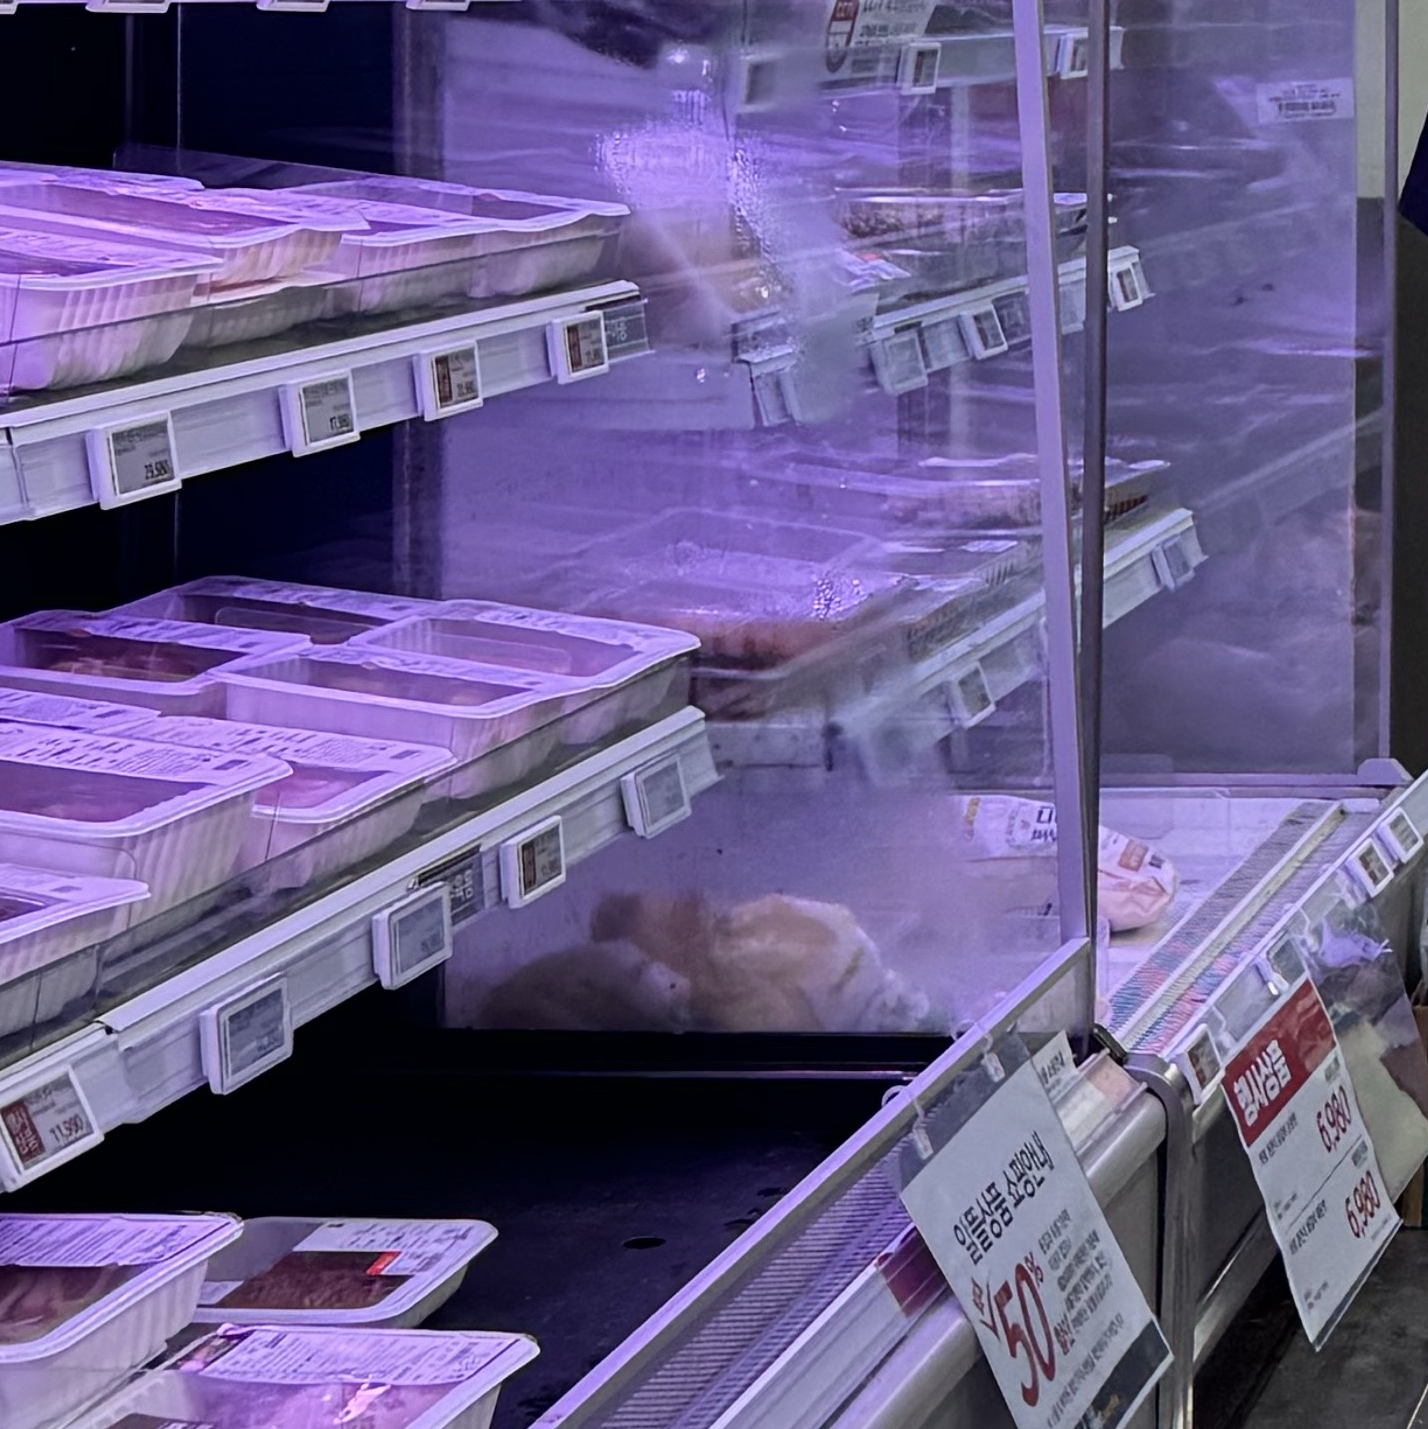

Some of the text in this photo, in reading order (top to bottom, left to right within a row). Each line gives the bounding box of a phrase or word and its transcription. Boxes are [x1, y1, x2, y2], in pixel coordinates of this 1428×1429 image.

[1231, 1035, 1293, 1130] 행사상품
[1313, 1082, 1358, 1160] 6,980
[950, 1125, 1056, 1271] 알뜰상품 쇼핑안내
[1341, 1167, 1384, 1246] 6,980
